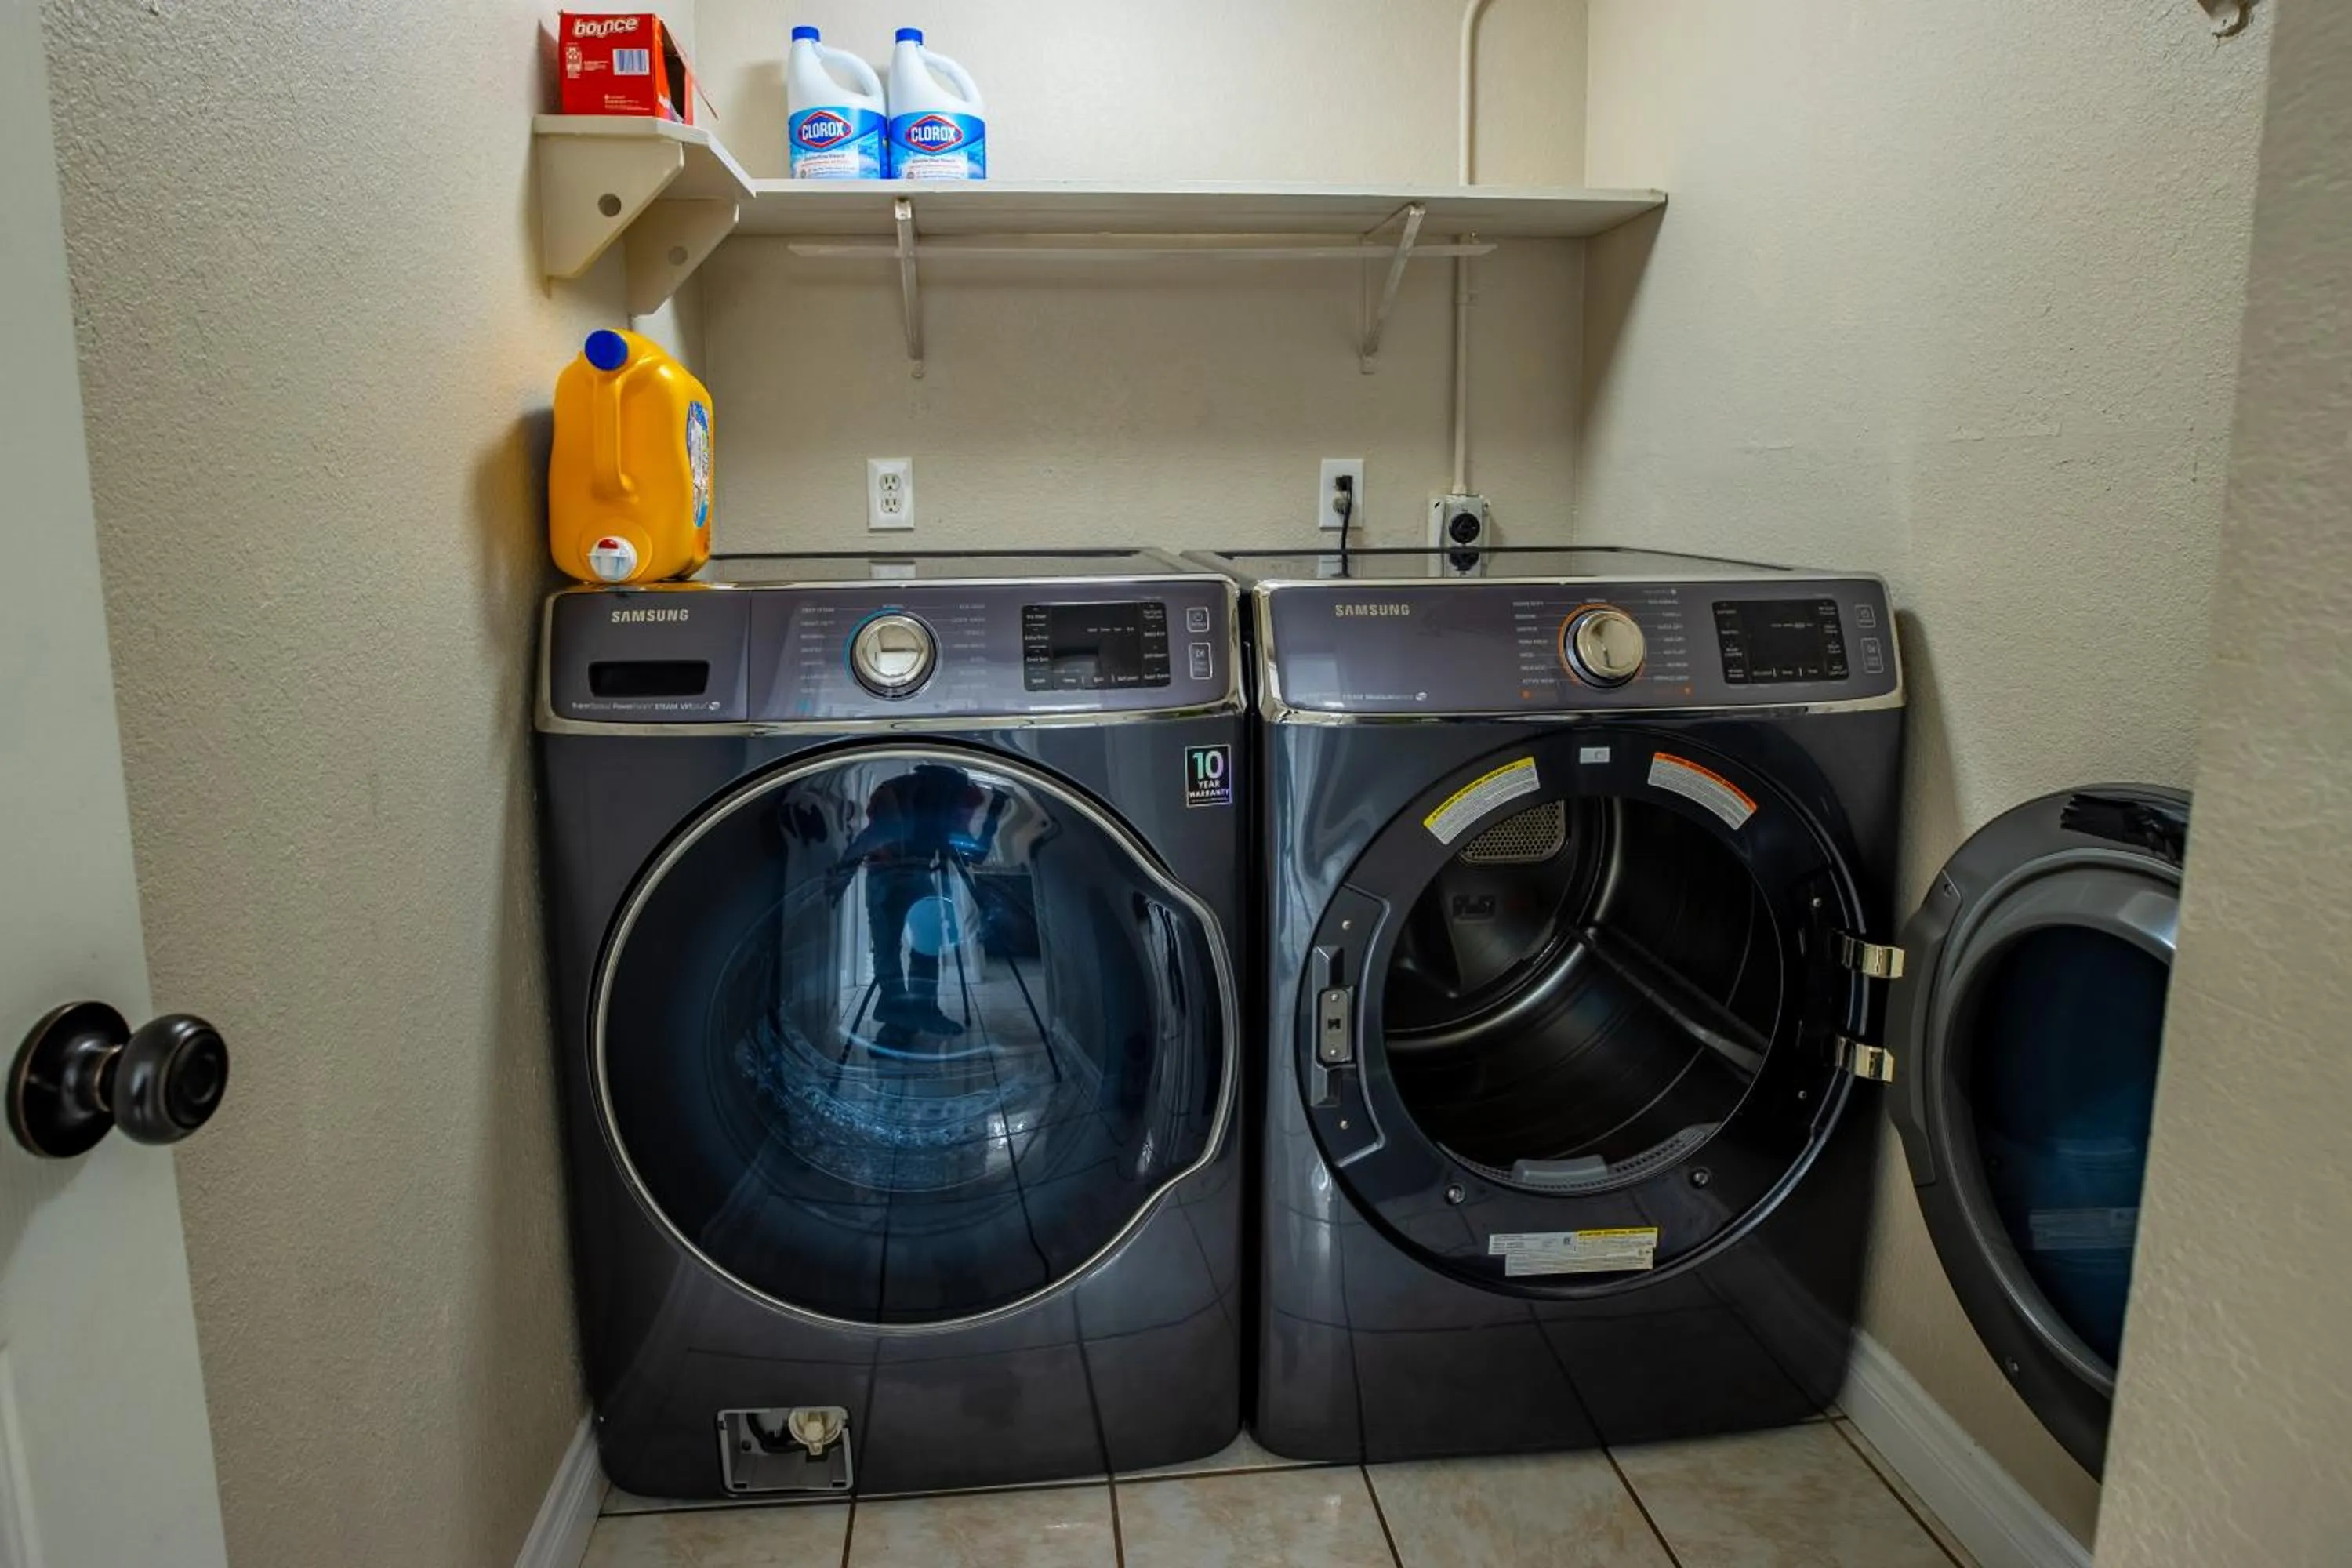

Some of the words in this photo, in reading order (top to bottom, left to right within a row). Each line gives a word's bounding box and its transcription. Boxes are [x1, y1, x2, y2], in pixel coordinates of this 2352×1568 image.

[574, 17, 639, 37] bounce
[801, 121, 844, 140] CLOROX
[911, 125, 956, 141] CLOROX
[612, 608, 689, 623] SAMSUNG
[1335, 604, 1410, 617] SAMSUNG
[1192, 751, 1224, 779] 10
[1198, 779, 1221, 789] YEAR
